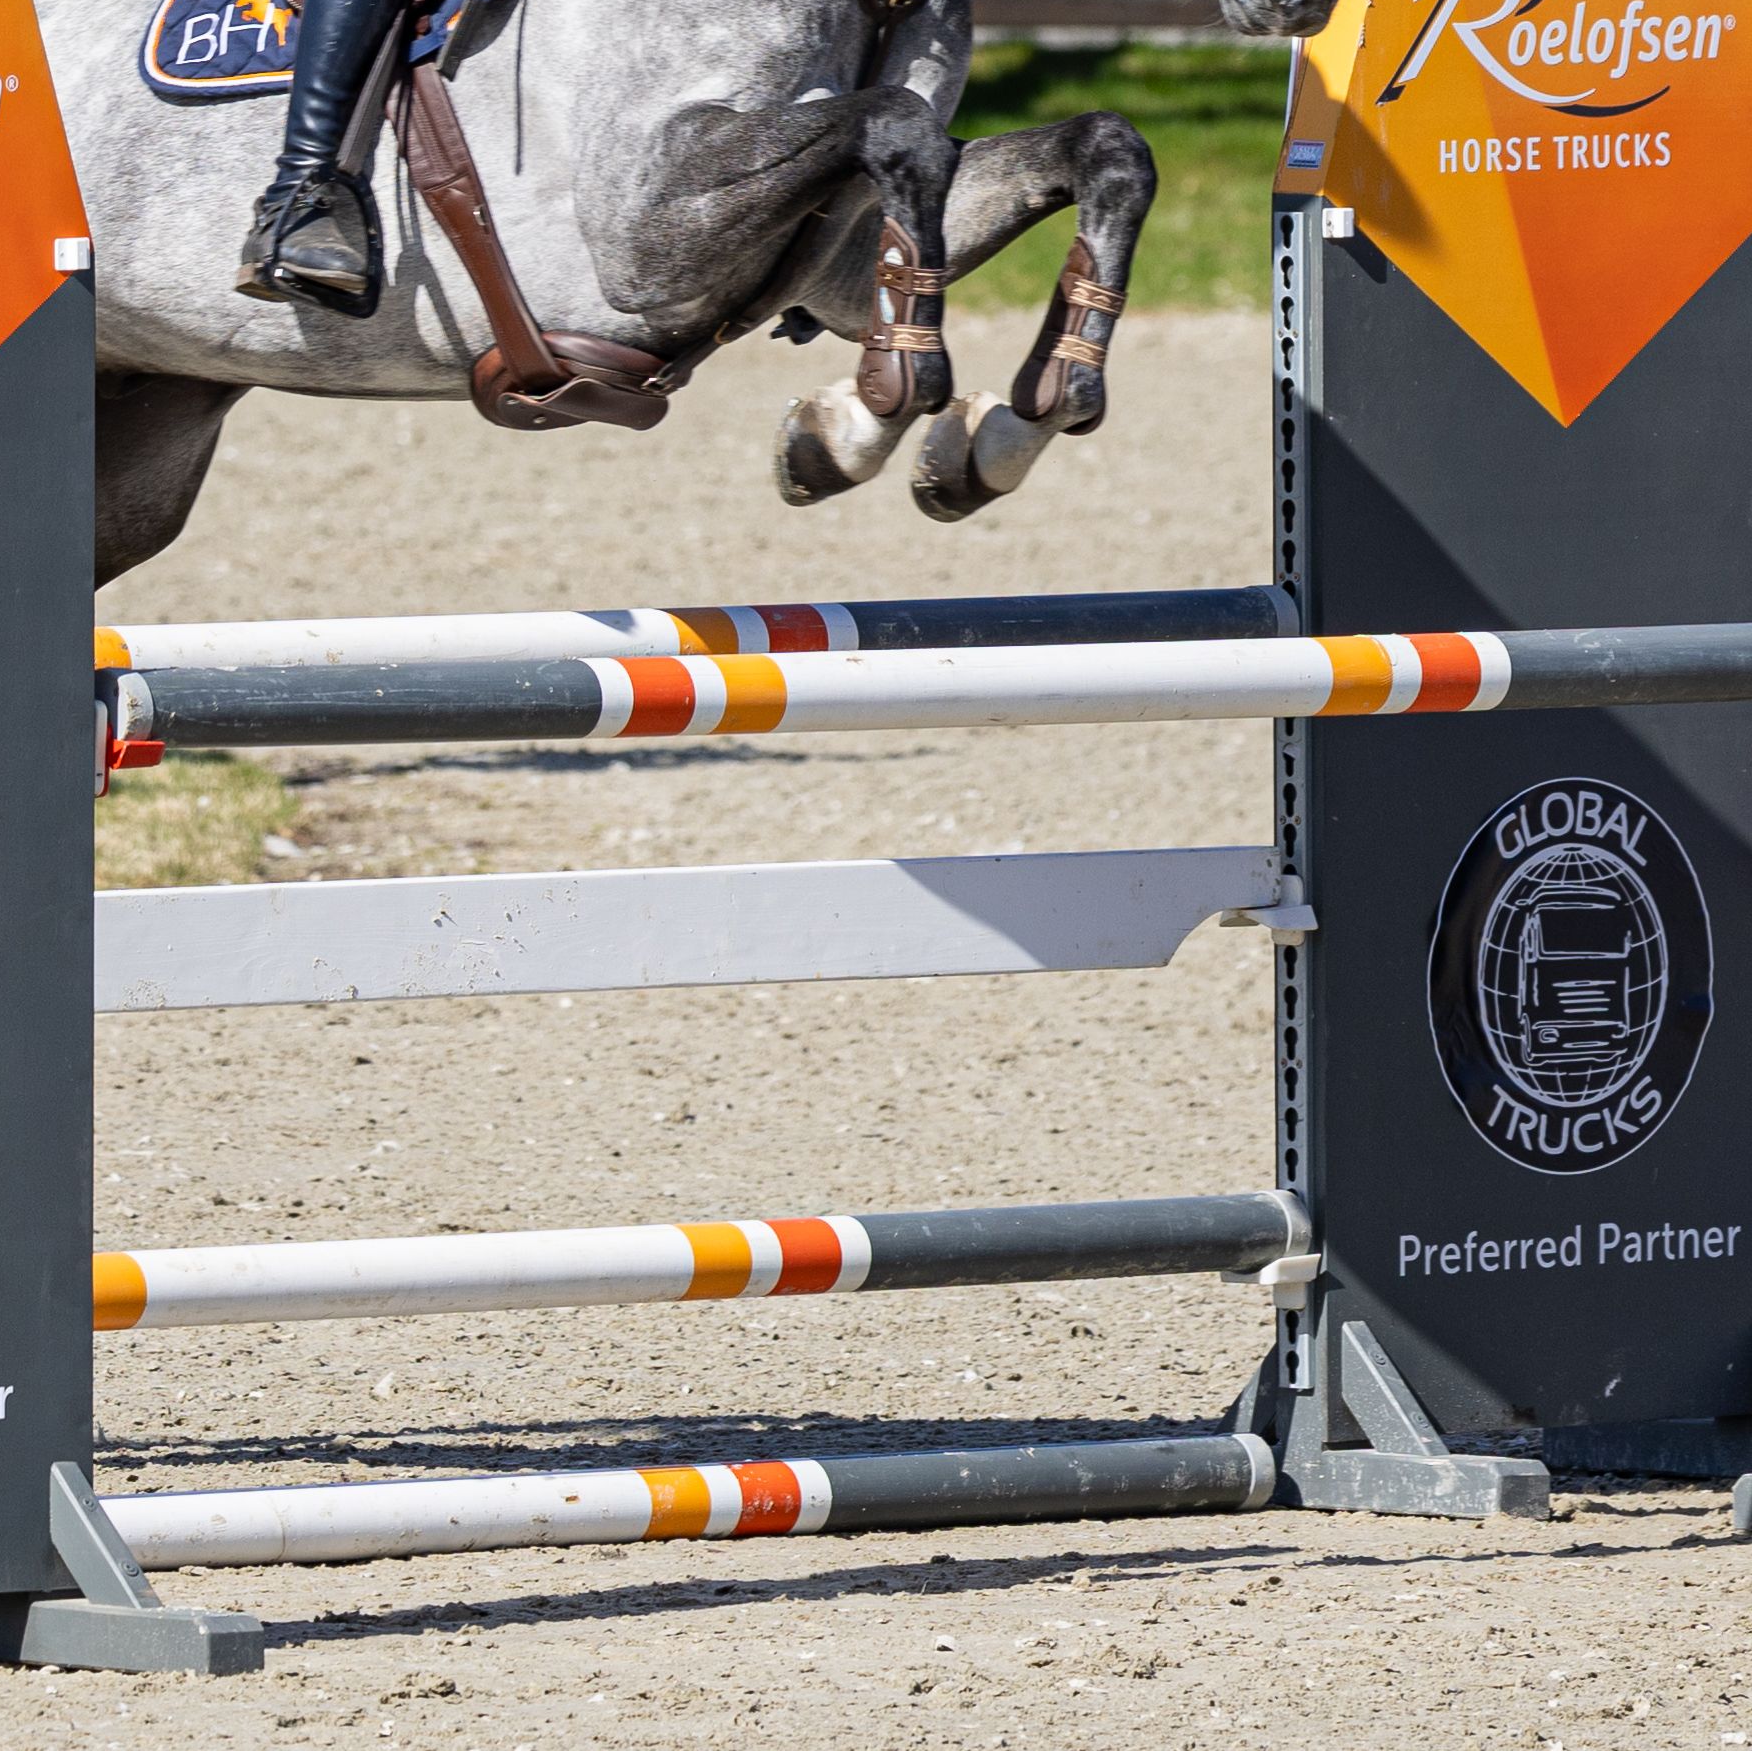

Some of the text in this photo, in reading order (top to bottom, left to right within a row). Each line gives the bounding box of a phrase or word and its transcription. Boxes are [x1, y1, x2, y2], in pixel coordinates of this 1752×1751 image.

[1439, 132, 1671, 173] HORSE TRUCKS
[1495, 790, 1648, 867] GLOBAL
[1487, 1075, 1662, 1155] TRUCKS
[1399, 1223, 1741, 1276] Preferred Partner
